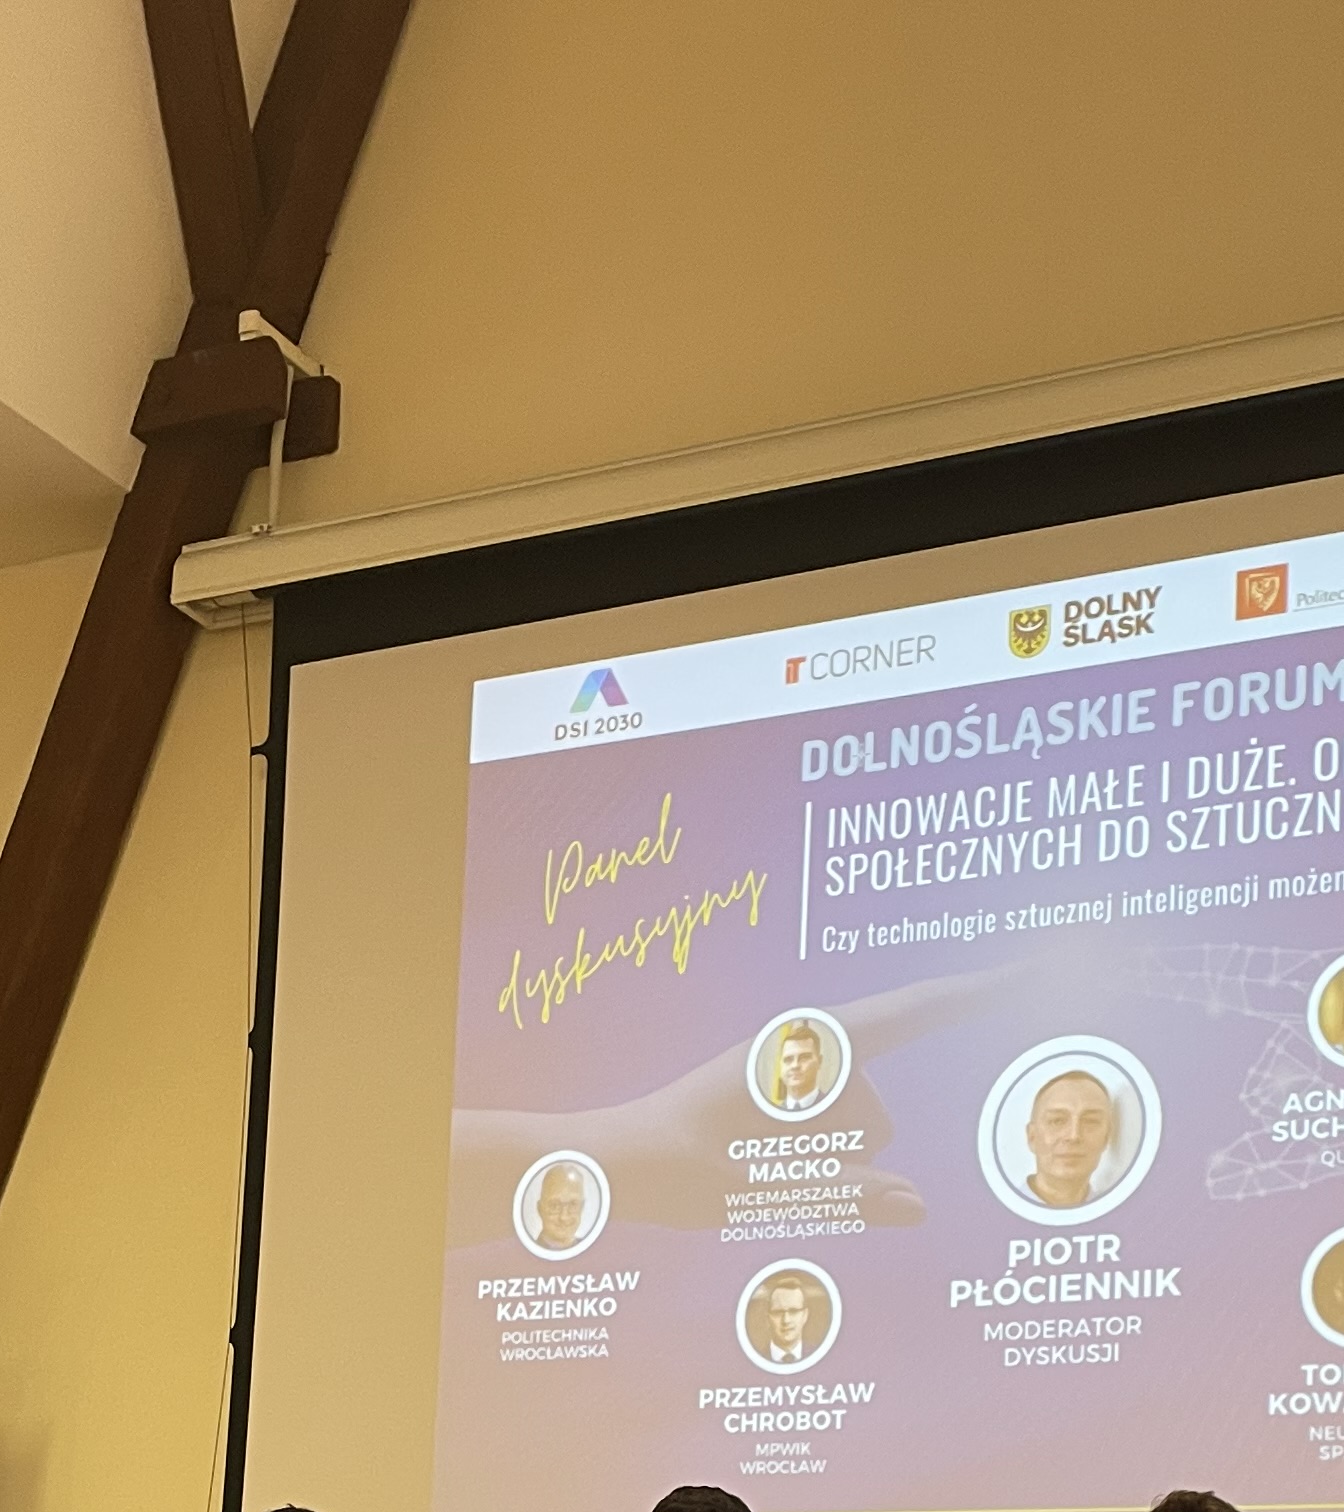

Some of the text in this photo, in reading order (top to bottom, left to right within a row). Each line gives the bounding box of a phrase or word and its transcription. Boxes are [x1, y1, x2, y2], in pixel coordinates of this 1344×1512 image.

[1062, 586, 1162, 624] DOLNY
[1062, 612, 1154, 648] ŚLĄSK
[810, 635, 937, 681] CORNER
[555, 712, 643, 741] DSI 2030
[801, 687, 1156, 783] DOLNOŚLĄSKIE
[827, 781, 1033, 849] INNOWACJE
[1047, 765, 1145, 819] MAŁE
[1160, 763, 1171, 802] I
[1188, 737, 1297, 799] DUŻE.
[543, 792, 683, 924] Panel
[824, 832, 1083, 897] SPOŁECZNYCH
[1099, 812, 1150, 862] DO
[822, 925, 860, 954] Czy
[867, 908, 997, 947] technologie
[1004, 897, 1113, 934] sztucznej
[1121, 874, 1259, 920] inteligencji
[498, 872, 769, 1029] dyskusyjny
[727, 1129, 865, 1161] GRZEGORZ
[748, 1157, 841, 1183] MACKO
[725, 1185, 863, 1208] WICEMARSZAŁEK
[727, 1201, 859, 1224] WOJEWÓDZTWA
[720, 1219, 866, 1242] DOLNOŚLĄSKIEGO
[1008, 1233, 1120, 1269] PIOTR
[478, 1271, 640, 1299] PRZEMYSŁAW
[949, 1267, 1182, 1310] PŁÓCIENNIK
[496, 1297, 617, 1321] KAZIENKO
[501, 1327, 609, 1345] POLITECHNIKA
[983, 1315, 1142, 1342] MODERATOR
[499, 1343, 609, 1361] WROCŁAWSKA
[1003, 1342, 1120, 1367] DYSKUSJI
[698, 1382, 875, 1410] PRZEMYSŁAW
[723, 1409, 847, 1433] CHROBOT
[755, 1442, 812, 1457] MPWIK
[739, 1459, 826, 1474] WROCŁAW
